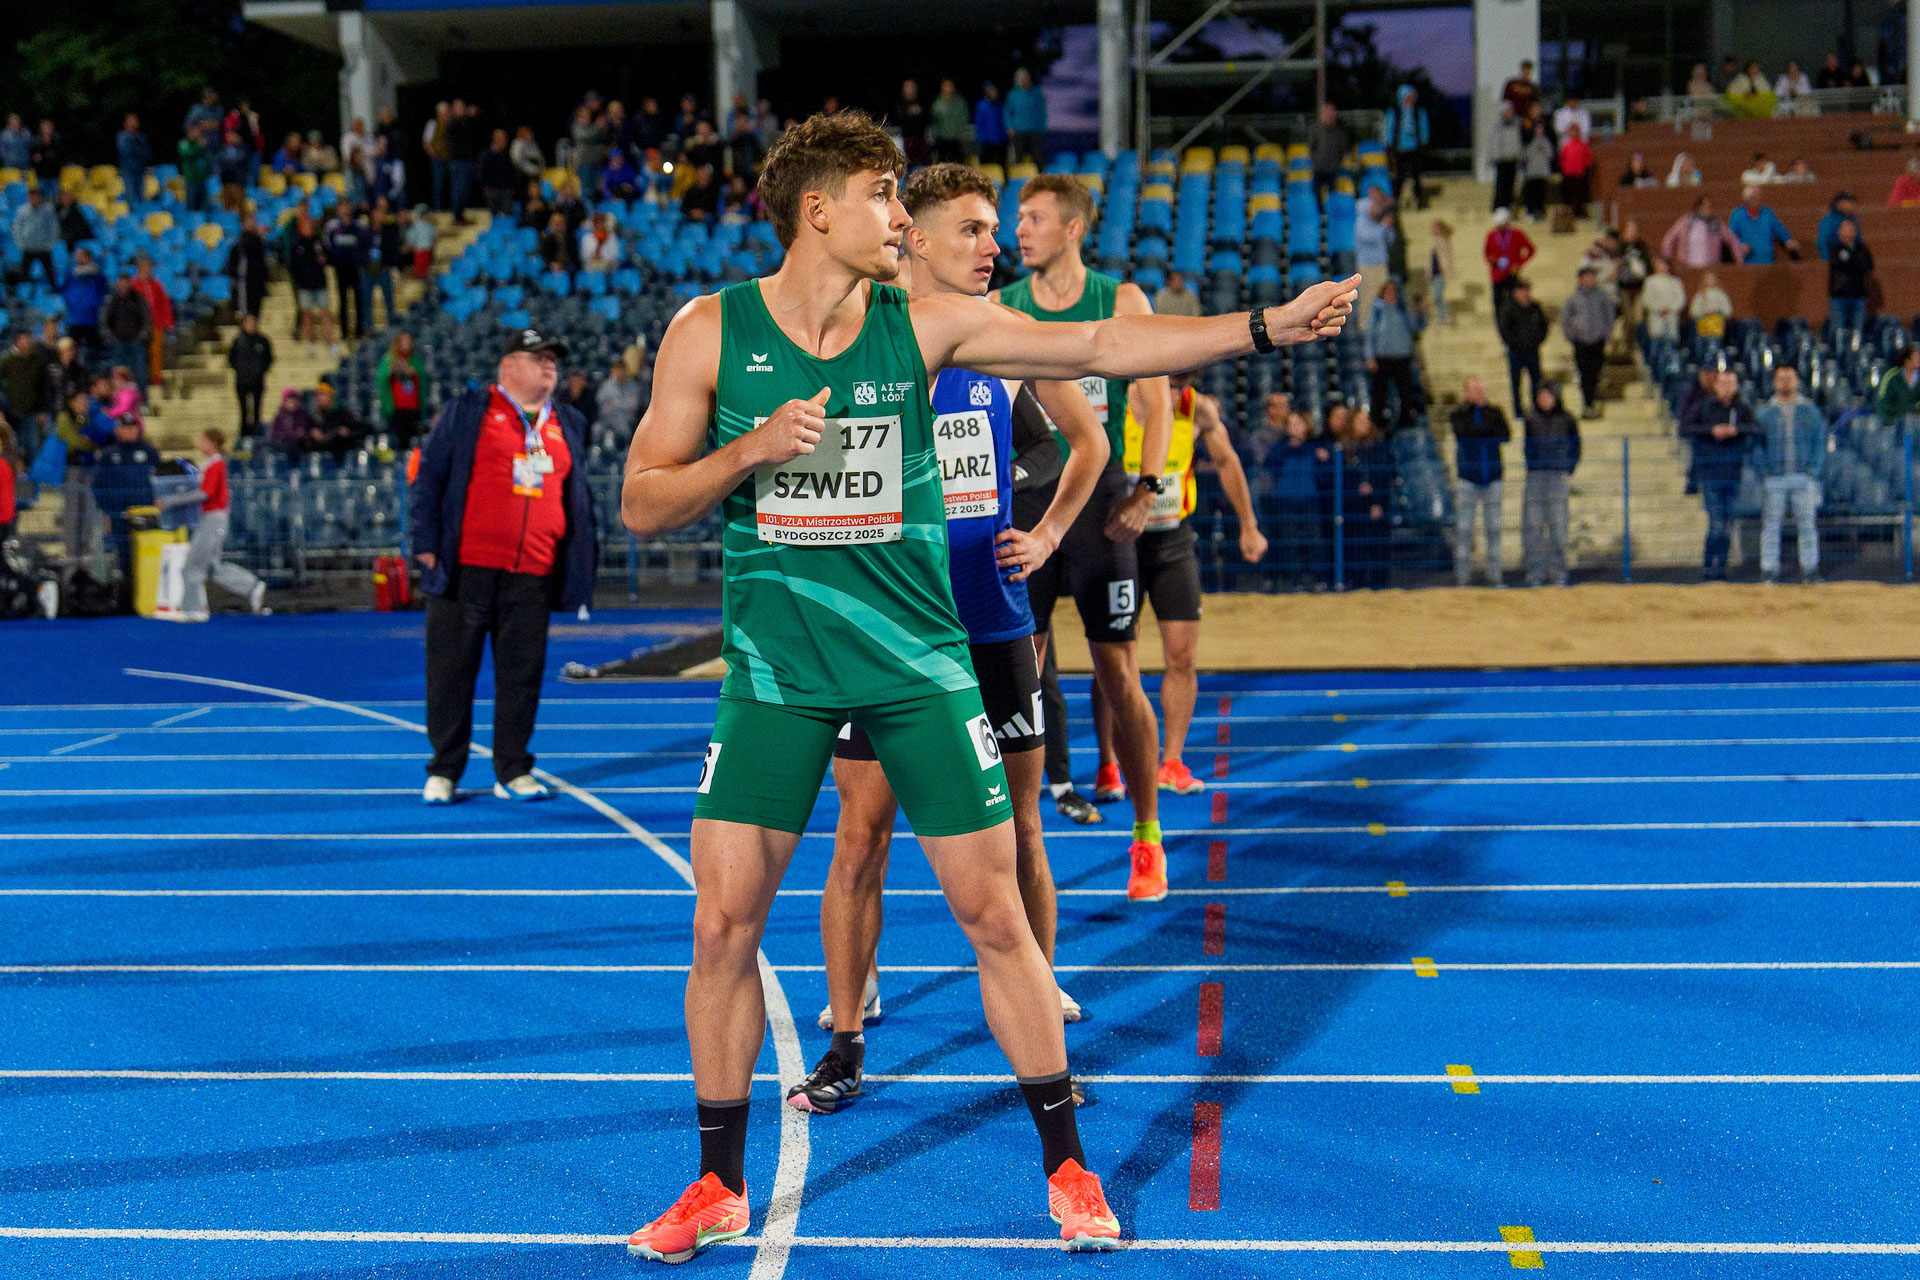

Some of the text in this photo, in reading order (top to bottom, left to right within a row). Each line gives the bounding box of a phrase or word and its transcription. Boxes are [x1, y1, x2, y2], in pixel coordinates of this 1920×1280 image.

[746, 363, 773, 372] erima
[1080, 379, 1103, 396] SKI
[938, 417, 981, 440] 488
[840, 424, 890, 450] 177
[774, 471, 883, 499] SZWED
[969, 491, 993, 500] Polski
[960, 504, 986, 514] 2025
[764, 513, 895, 526] 101. PZLA Mistrzostwa Polski
[775, 528, 885, 541] BYDGOSZCZ 2025
[1118, 584, 1130, 610] 5
[979, 718, 999, 760] 6
[985, 793, 1007, 807] erima
